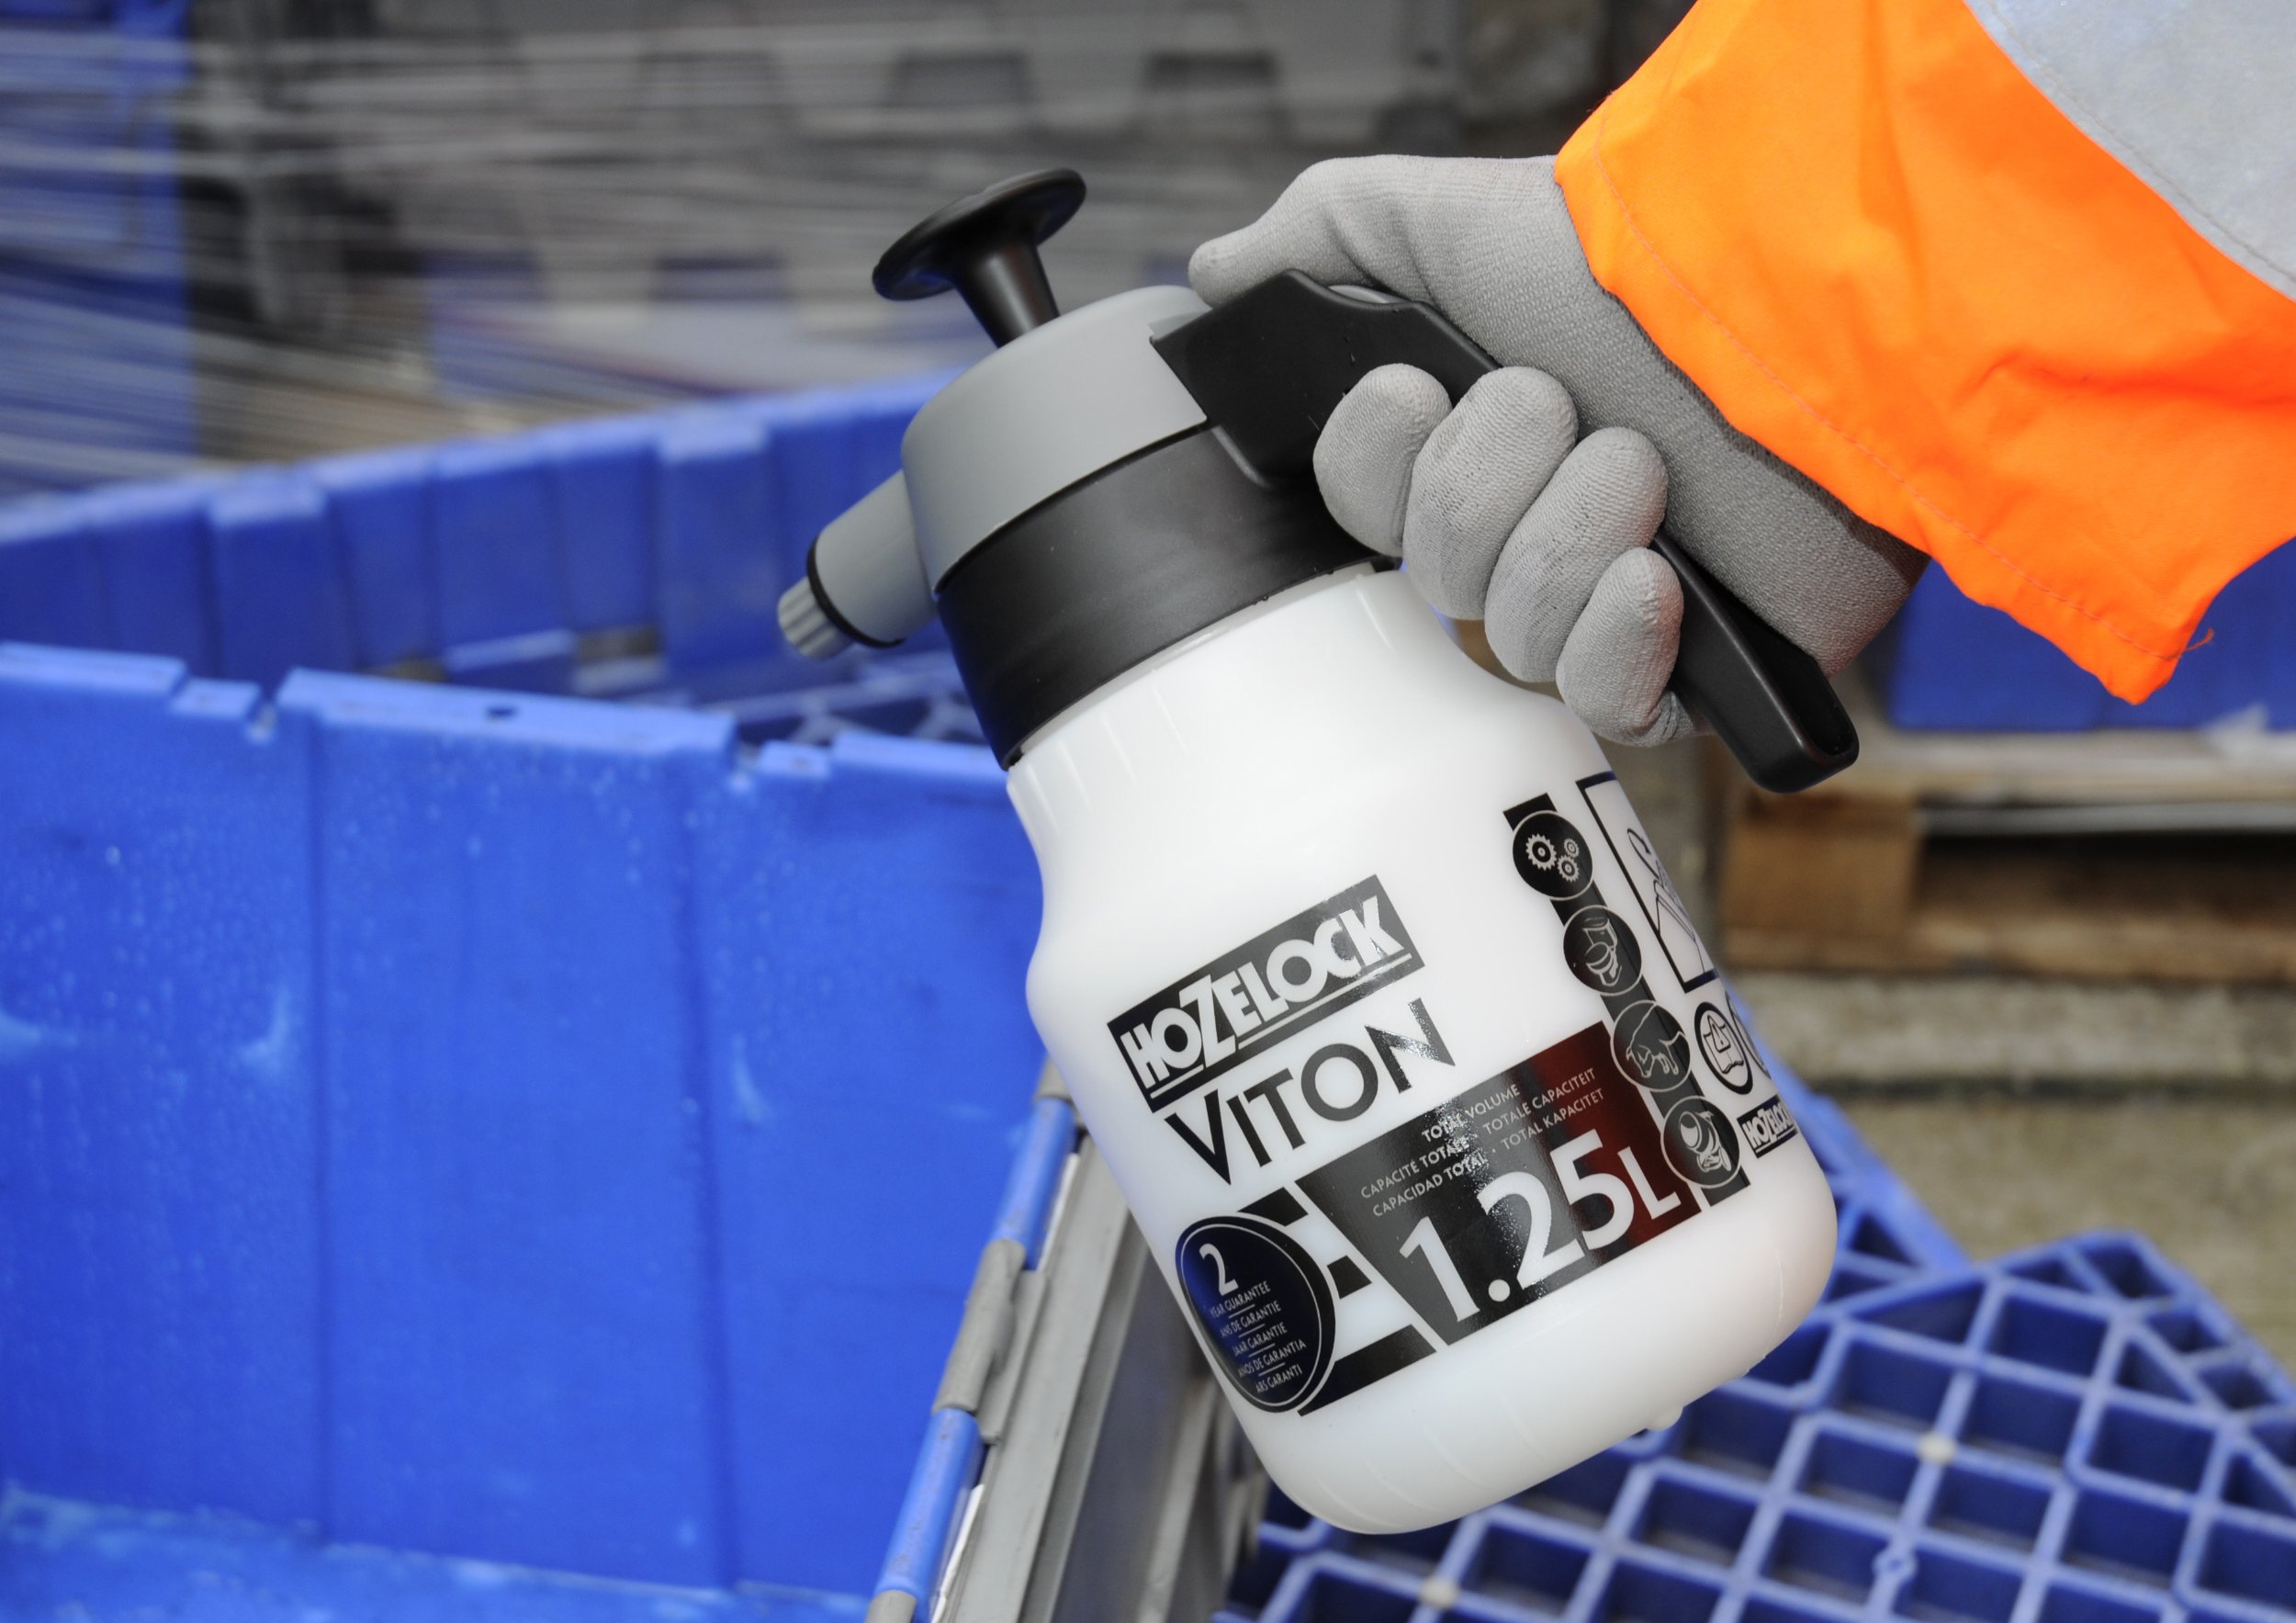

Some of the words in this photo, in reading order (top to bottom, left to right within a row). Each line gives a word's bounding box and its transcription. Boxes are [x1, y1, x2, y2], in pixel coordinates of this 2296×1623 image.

[1120, 895, 1404, 1090] HOZELOCK
[1165, 997, 1456, 1186] VITON
[1420, 1135, 1469, 1167] TOTALE
[1482, 1103, 1531, 1135] TOTALE
[1532, 1067, 1597, 1110] CAPACITEIT
[1422, 1112, 1463, 1143] TOTAL
[1466, 1084, 1520, 1119] VOLUME
[1372, 1174, 1443, 1217] CAPACIDAD
[1444, 1151, 1488, 1179] TOTAL
[1501, 1121, 1543, 1150] TOTAL
[1543, 1088, 1604, 1129] KAPACITET
[1199, 1243, 1239, 1296] 2
[1210, 1302, 1226, 1319] YEAR
[1224, 1280, 1271, 1312] GUARANTEE
[1220, 1323, 1233, 1337] ANS
[1231, 1319, 1242, 1332] DE
[1241, 1300, 1281, 1328] GARANTIE
[1232, 1340, 1248, 1357] JAAR
[1248, 1322, 1288, 1349] GARANTIE
[1253, 1358, 1264, 1370] DE
[1263, 1338, 1307, 1366] GARANTIA
[1268, 1363, 1303, 1389] GARANTI
